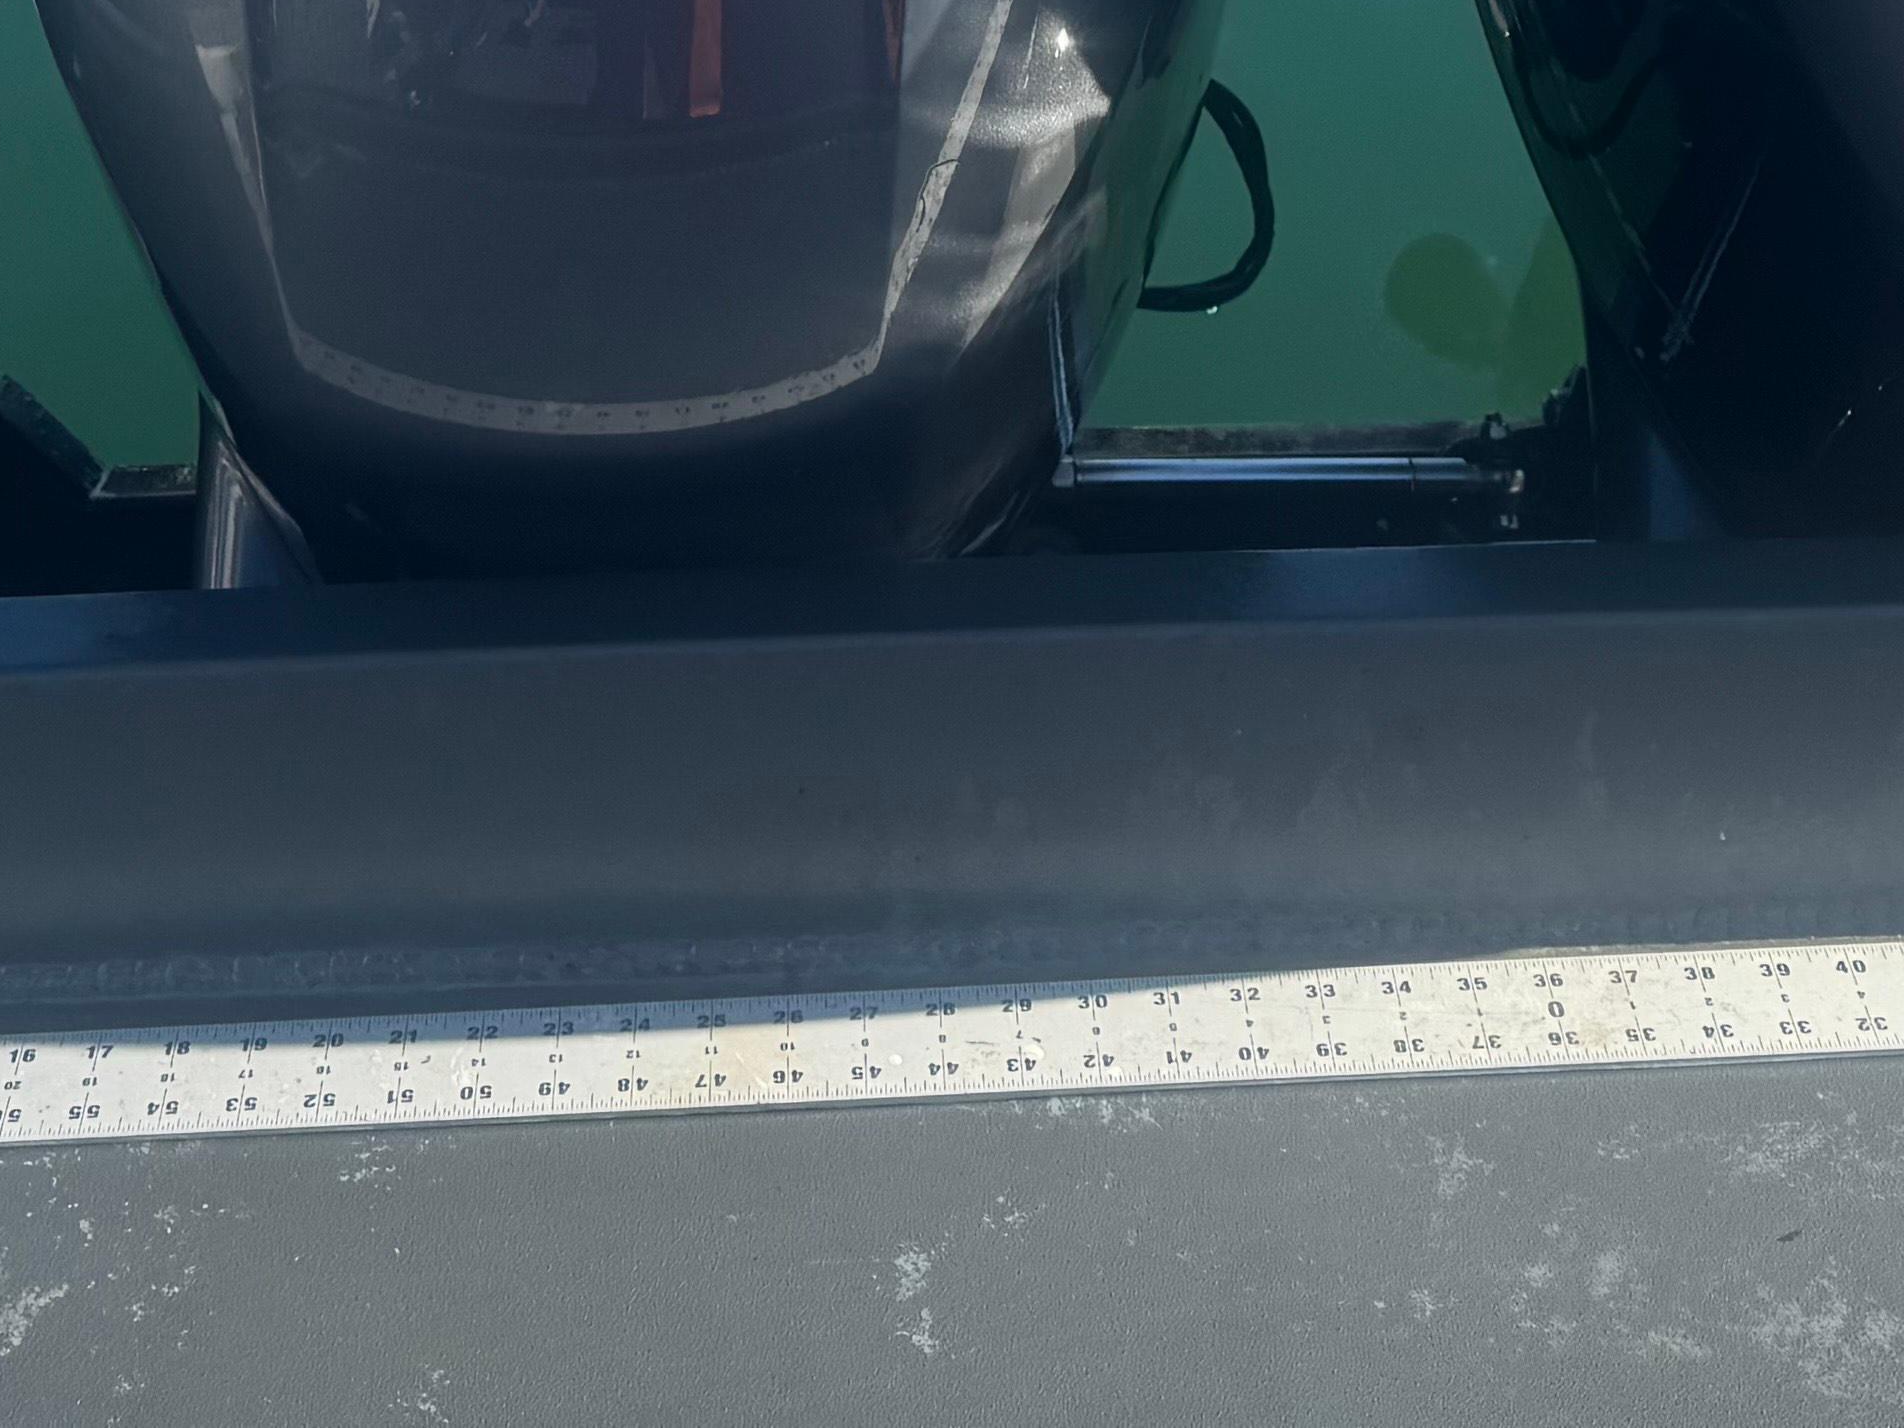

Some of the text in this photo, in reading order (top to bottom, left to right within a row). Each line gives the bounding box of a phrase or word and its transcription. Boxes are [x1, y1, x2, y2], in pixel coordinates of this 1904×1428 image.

[10, 1049, 36, 1063] 16
[87, 1045, 114, 1059] 17
[165, 1042, 190, 1056] 18
[241, 1038, 267, 1052] 19
[315, 1033, 344, 1047] 20
[390, 1030, 417, 1044] 21
[467, 1026, 498, 1040] 22
[543, 1023, 574, 1037] 23
[620, 1019, 650, 1033] 24
[697, 1016, 726, 1030] 25
[773, 1010, 804, 1023] 26
[849, 1006, 877, 1019] 27
[926, 1003, 955, 1016] 28
[1002, 999, 1032, 1012] 29
[1078, 996, 1108, 1009] 30
[1153, 993, 1181, 1006] 31
[1230, 988, 1261, 1001] 32
[1305, 985, 1335, 998] 33
[1381, 982, 1412, 995] 34
[1457, 978, 1487, 991] 35
[1534, 975, 1563, 988] 36
[1610, 971, 1638, 984] 37
[1684, 966, 1715, 981] 38
[1760, 963, 1791, 978] 39
[1836, 959, 1866, 974] 40
[1548, 1001, 1565, 1018] 0
[1702, 1023, 1734, 1039] 34
[1780, 1020, 1812, 1036] 33
[1856, 1016, 1888, 1032] 32
[1549, 1032, 1579, 1047] 36
[1626, 1029, 1657, 1044] 35
[1239, 1046, 1270, 1061] 40
[1316, 1042, 1347, 1057] 39
[1007, 1059, 1036, 1073] 43
[1083, 1056, 1115, 1070] 42
[773, 1070, 804, 1084] 46
[460, 1086, 492, 1101] 50
[538, 1082, 570, 1097] 49
[618, 1079, 648, 1094] 48
[226, 1097, 257, 1113] 53
[304, 1093, 336, 1108] 52
[69, 1104, 100, 1120] 55
[147, 1101, 179, 1117] 54
